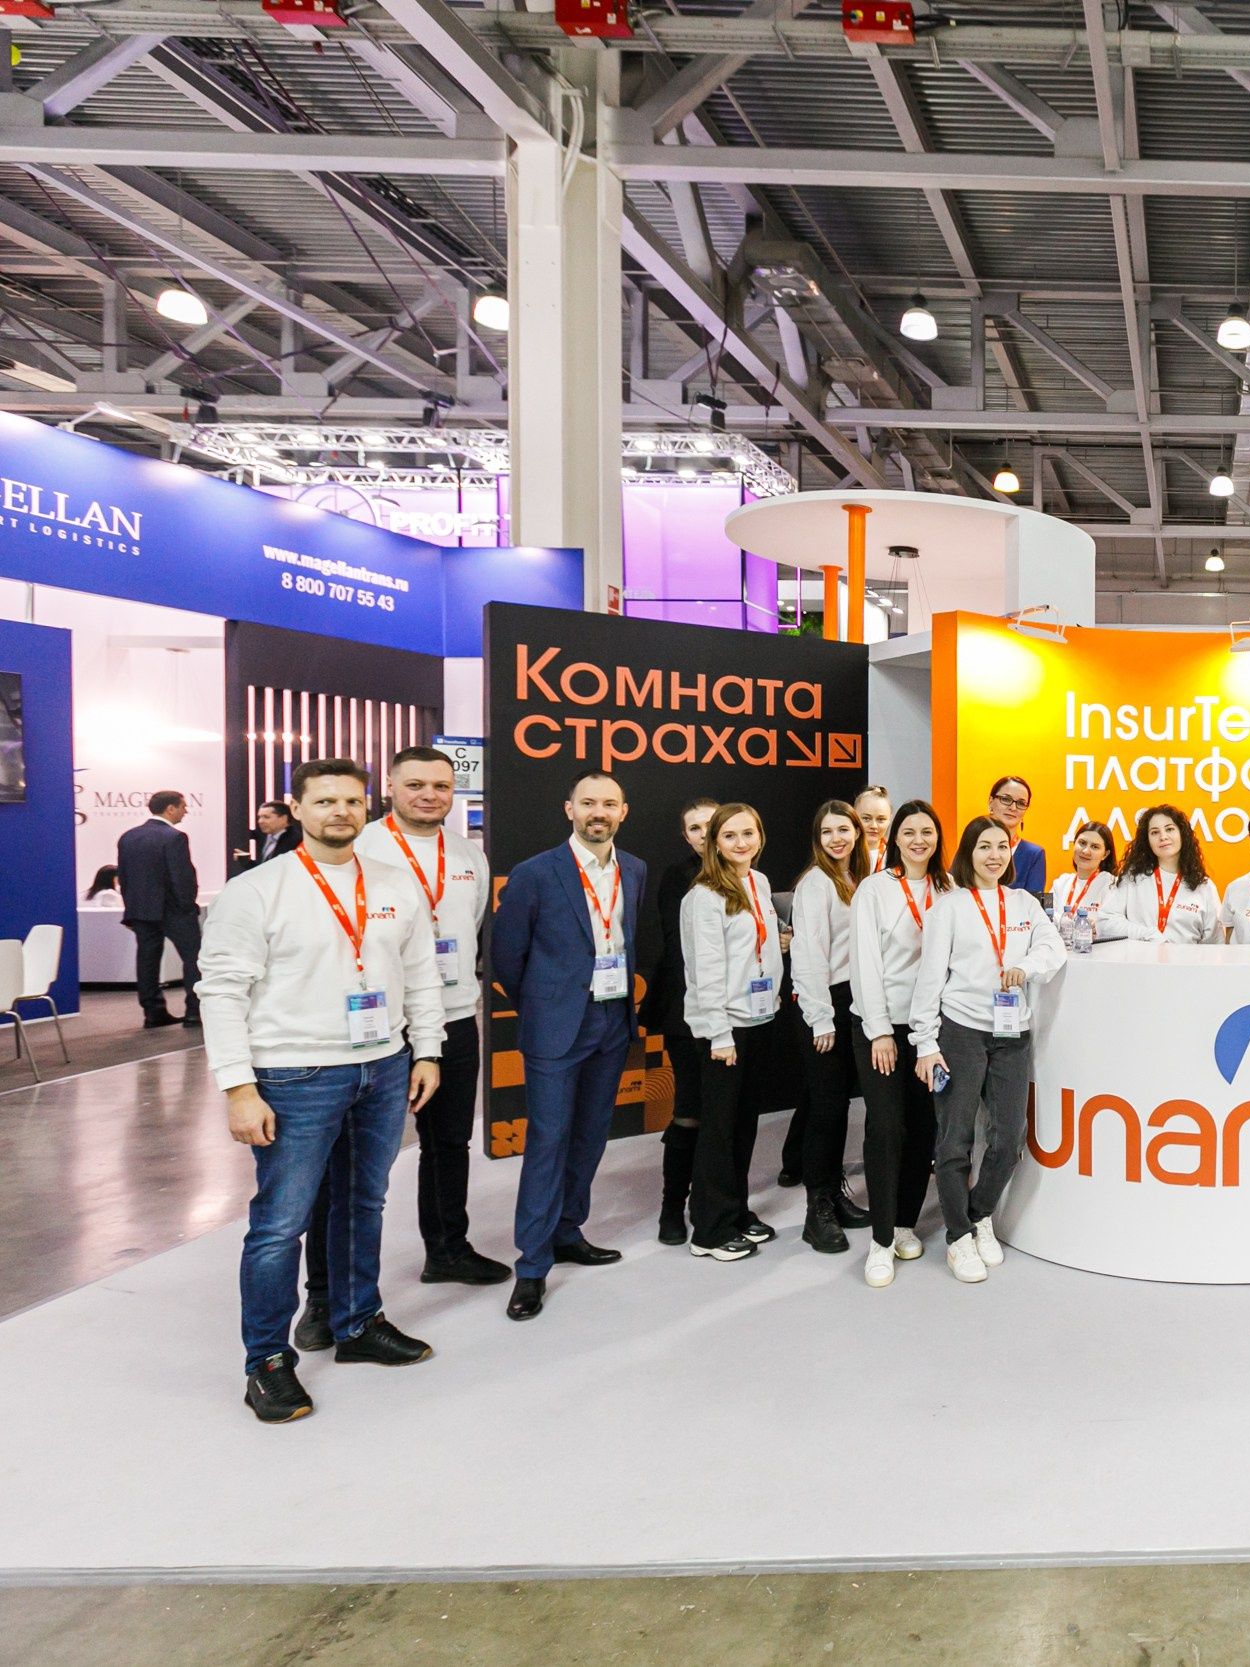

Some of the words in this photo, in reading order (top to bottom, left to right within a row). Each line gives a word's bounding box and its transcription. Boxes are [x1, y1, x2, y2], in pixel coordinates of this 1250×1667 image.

[0, 477, 143, 541] ELLAN
[30, 522, 140, 556] LOGISTICS
[262, 545, 409, 592] www.magellantrans.ru
[281, 572, 293, 589] 8
[295, 575, 325, 596] 800
[328, 582, 354, 602] 707
[357, 589, 375, 608] 55
[377, 594, 395, 612] 43
[516, 643, 822, 719] Комната
[513, 714, 777, 772] страха
[452, 760, 479, 772] 097
[1062, 806, 1150, 850] дл
[366, 912, 395, 920] unami
